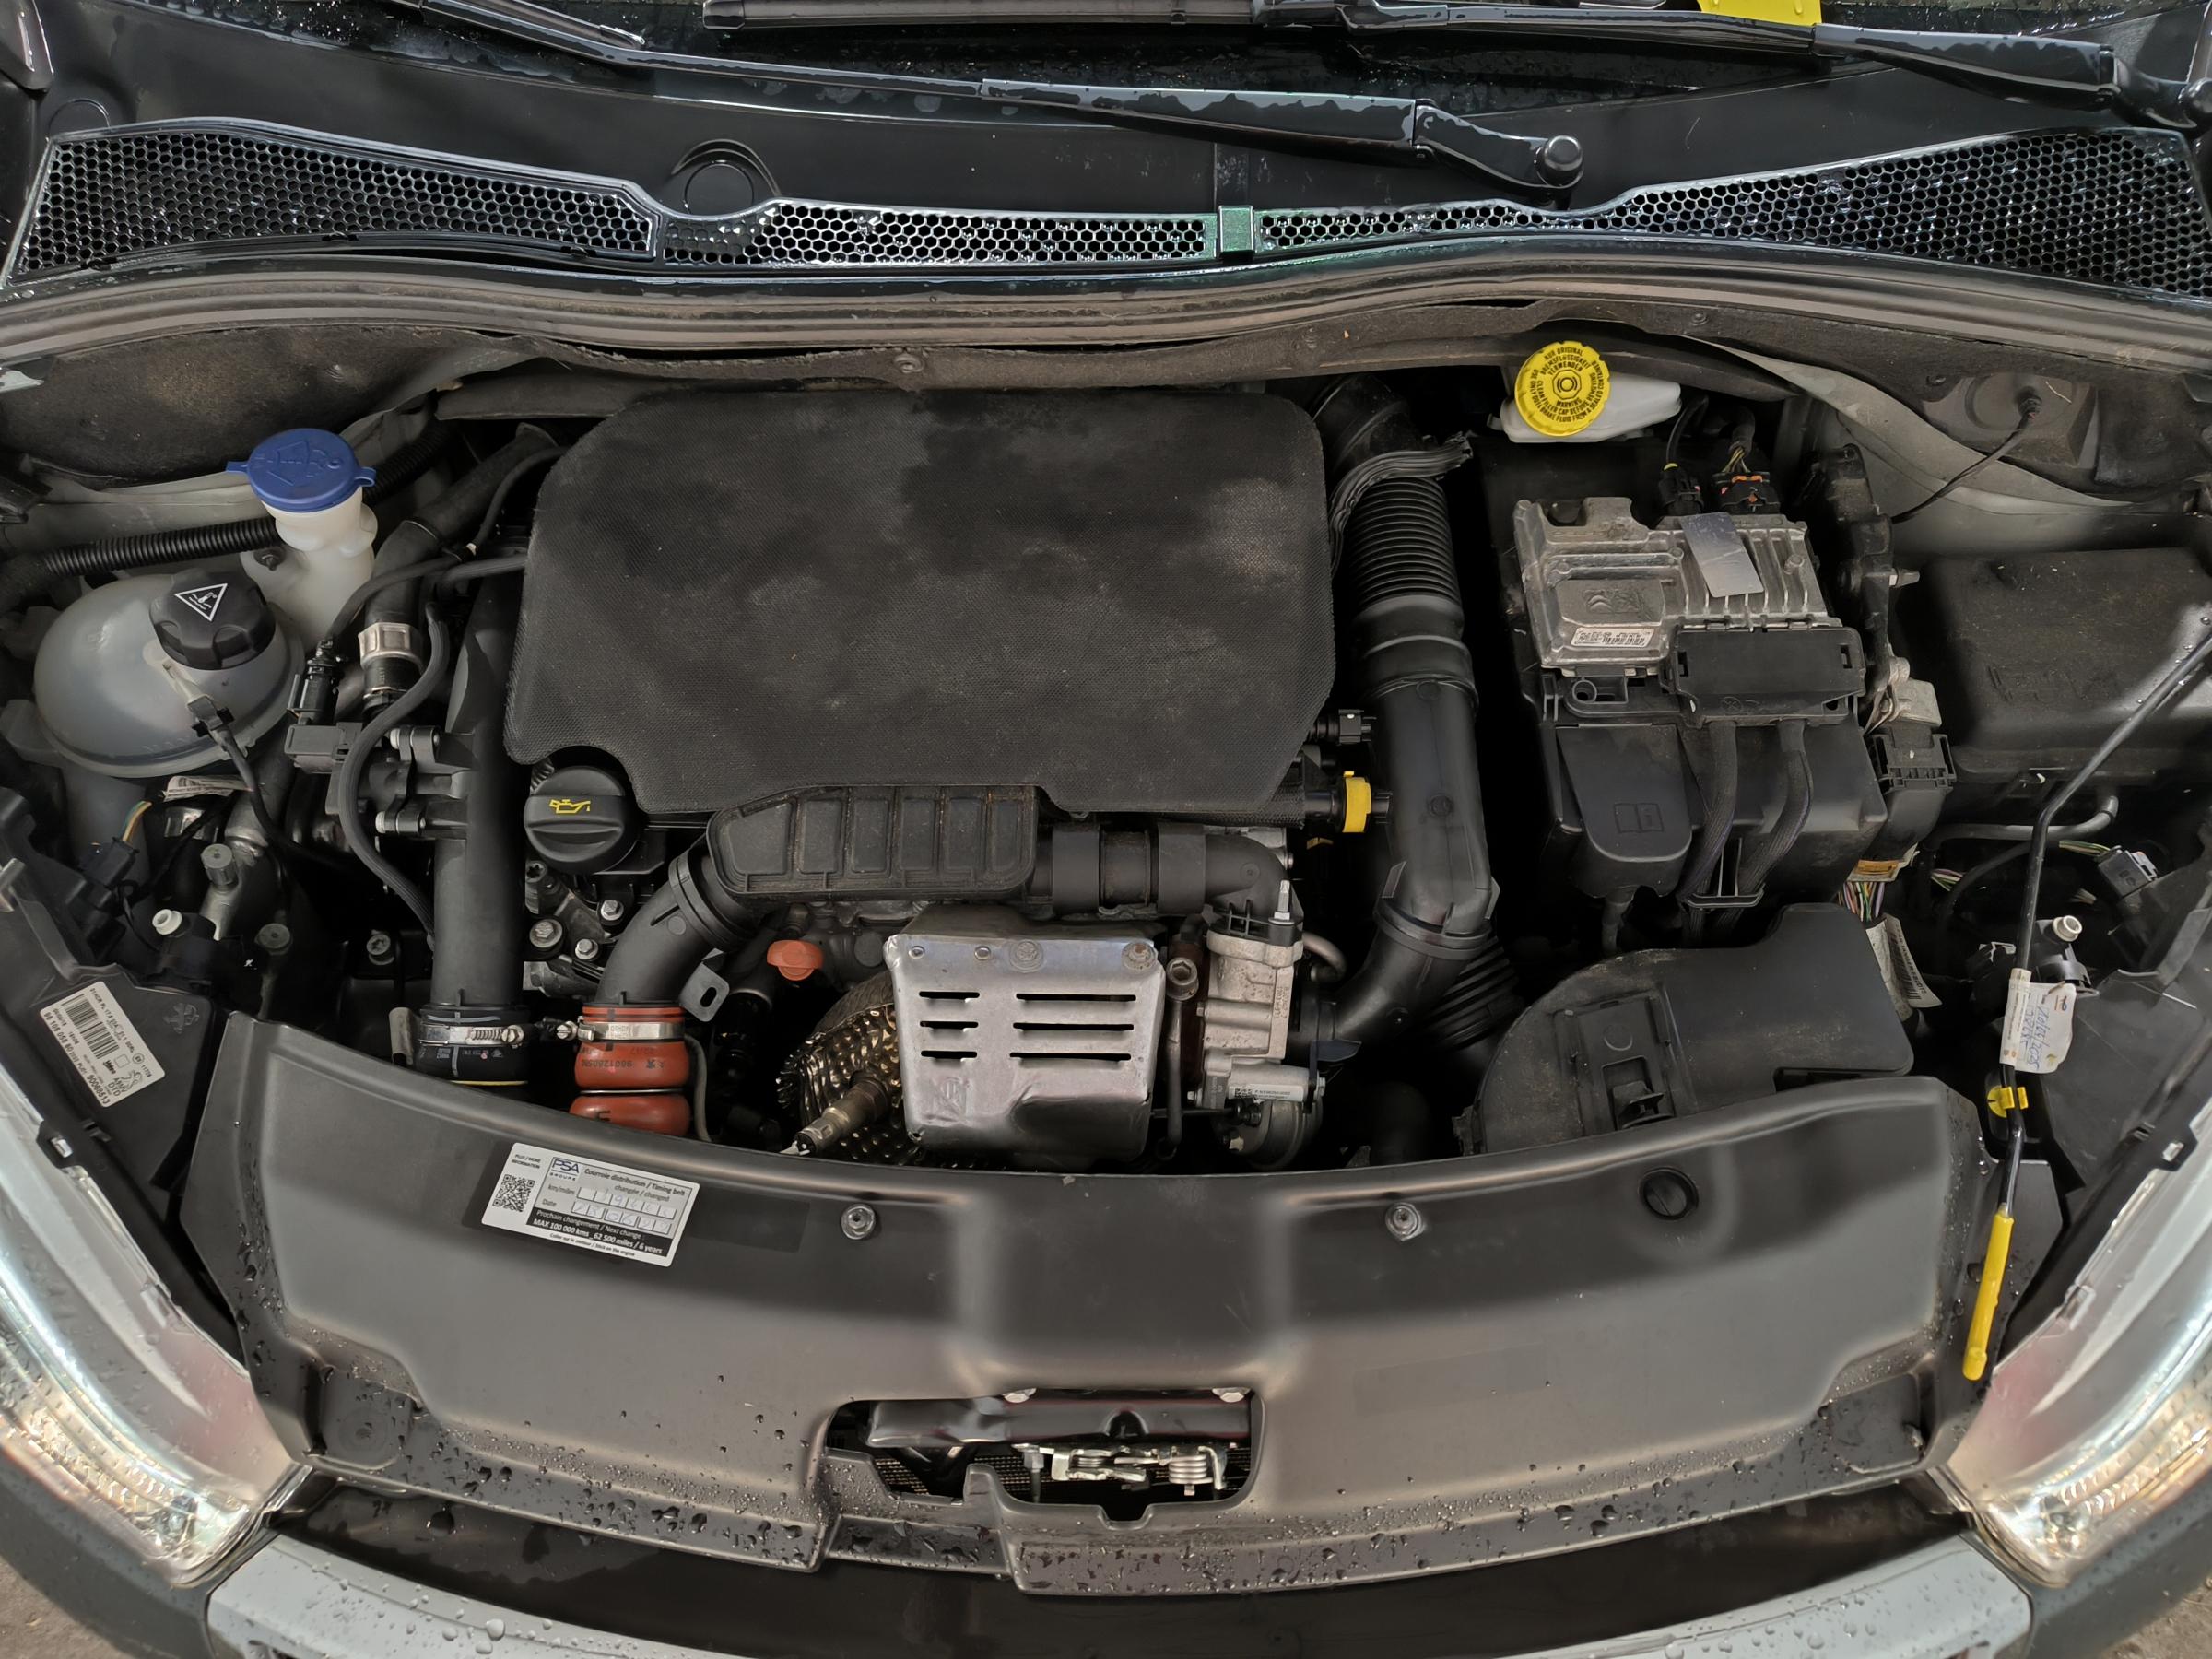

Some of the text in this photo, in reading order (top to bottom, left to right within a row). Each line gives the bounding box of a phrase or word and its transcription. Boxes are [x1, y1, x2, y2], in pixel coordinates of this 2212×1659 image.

[1557, 347, 1583, 356] ORIGINAL
[552, 1159, 579, 1173] PSA
[610, 1174, 646, 1187] distribution
[652, 1183, 672, 1194] Timing
[542, 1198, 557, 1206] Date
[536, 1209, 562, 1220] Prochain
[563, 1216, 600, 1230] changement
[605, 1226, 619, 1234] Next
[619, 1230, 642, 1240] change
[533, 1218, 550, 1228] MAX
[563, 1225, 575, 1233] 000
[576, 1228, 590, 1237] kms
[616, 1239, 633, 1247] miles
[644, 1245, 663, 1253] years
